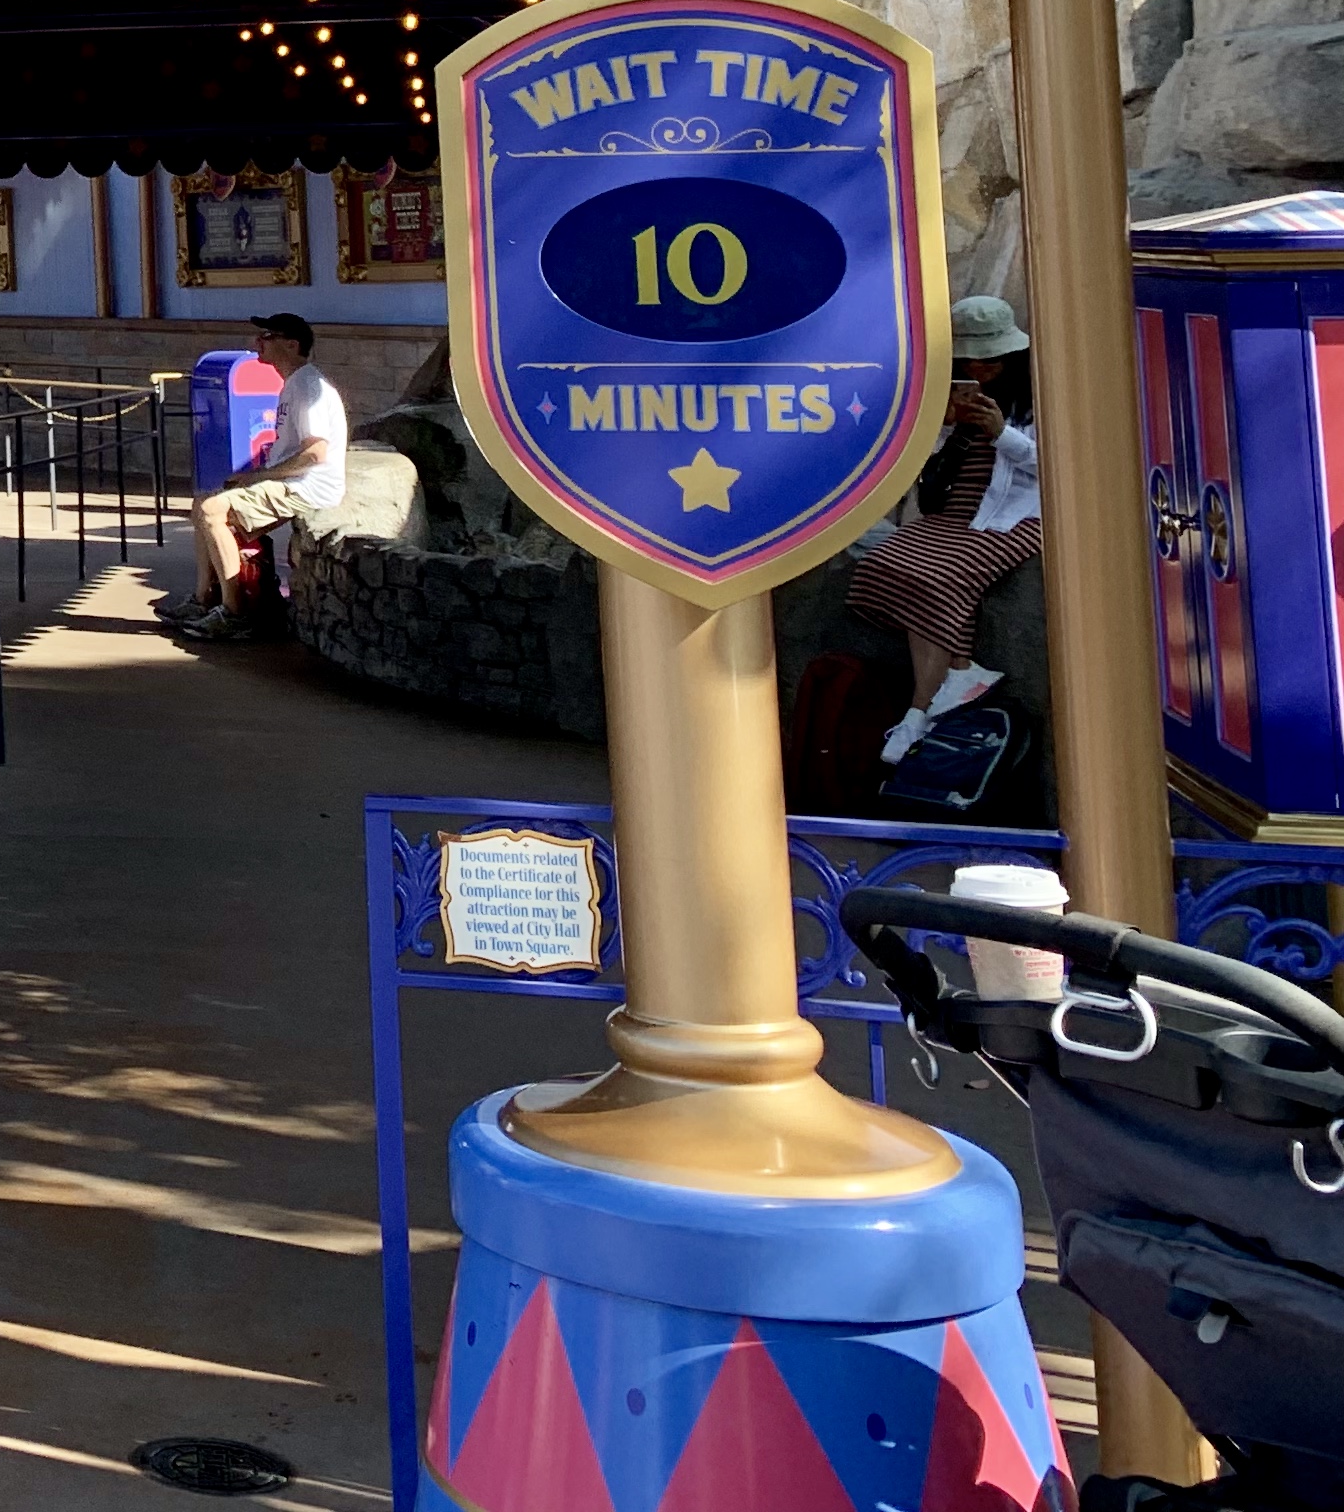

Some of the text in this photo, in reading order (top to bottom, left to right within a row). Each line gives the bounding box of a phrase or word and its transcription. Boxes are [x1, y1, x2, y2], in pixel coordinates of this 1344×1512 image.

[511, 48, 860, 131] WAIT TIME
[632, 222, 748, 306] 10
[568, 384, 836, 433] MINUTES
[460, 847, 578, 867] Documents related
[460, 867, 577, 884] to the Certificate of
[459, 882, 580, 903] Compliance for this
[467, 901, 577, 922] attraction may be
[465, 918, 580, 939] viewed at City Hall
[475, 936, 574, 957] in Town Square.
